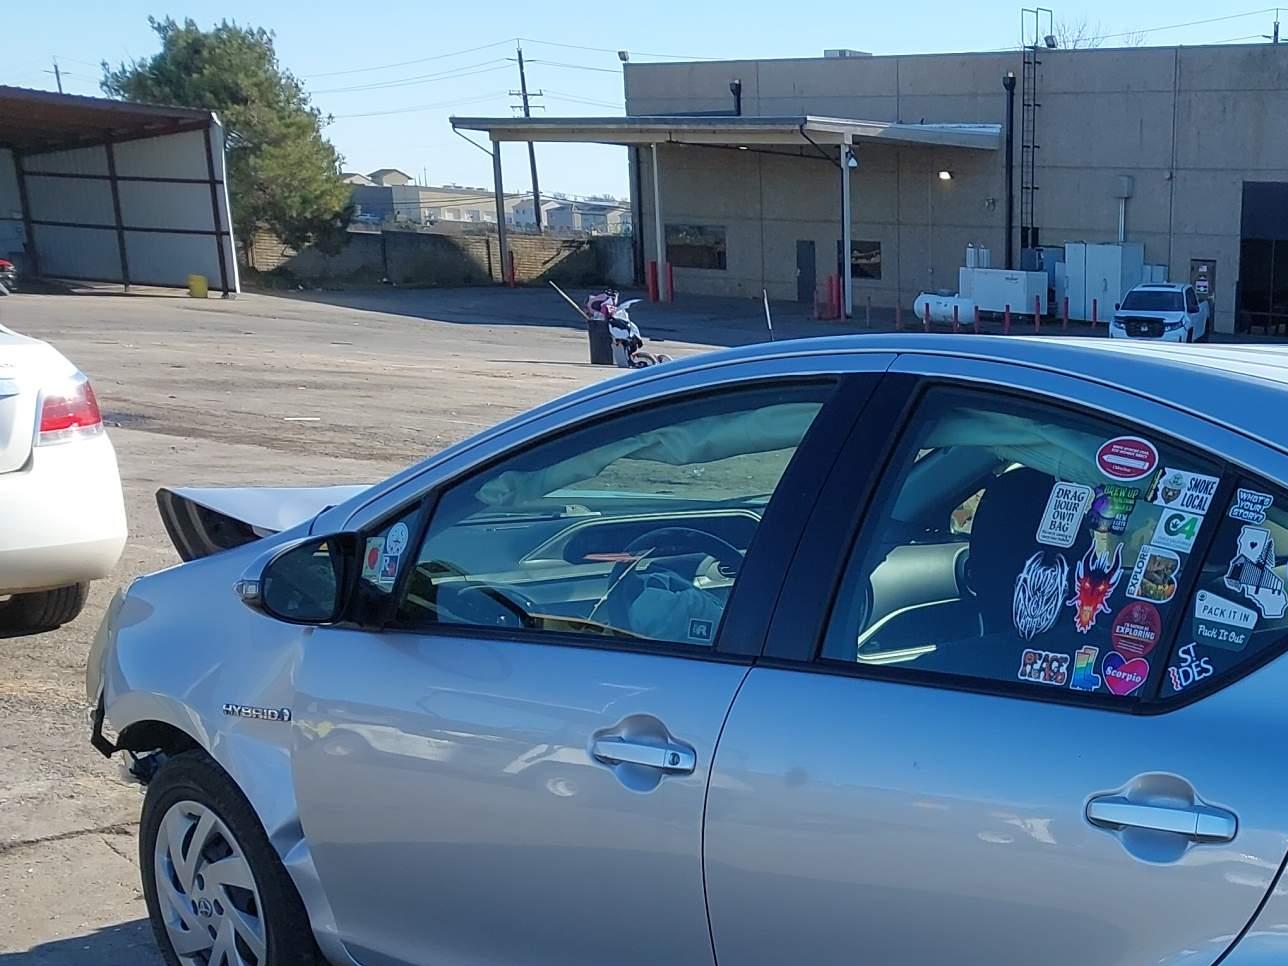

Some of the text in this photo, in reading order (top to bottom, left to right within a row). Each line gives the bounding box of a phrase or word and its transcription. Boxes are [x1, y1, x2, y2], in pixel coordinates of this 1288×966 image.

[1055, 487, 1086, 503] DRAG
[1187, 477, 1217, 497] SMOKE
[1180, 492, 1208, 512] LOCAL
[1048, 520, 1069, 533] BAG
[1127, 545, 1150, 596] EXPLORE
[1202, 604, 1250, 623] PACK IT IN
[1115, 625, 1156, 641] EXPLORING
[1197, 624, 1246, 644] Pack It Out
[1105, 665, 1142, 683] Scorpio
[222, 703, 279, 721] HYBRID
